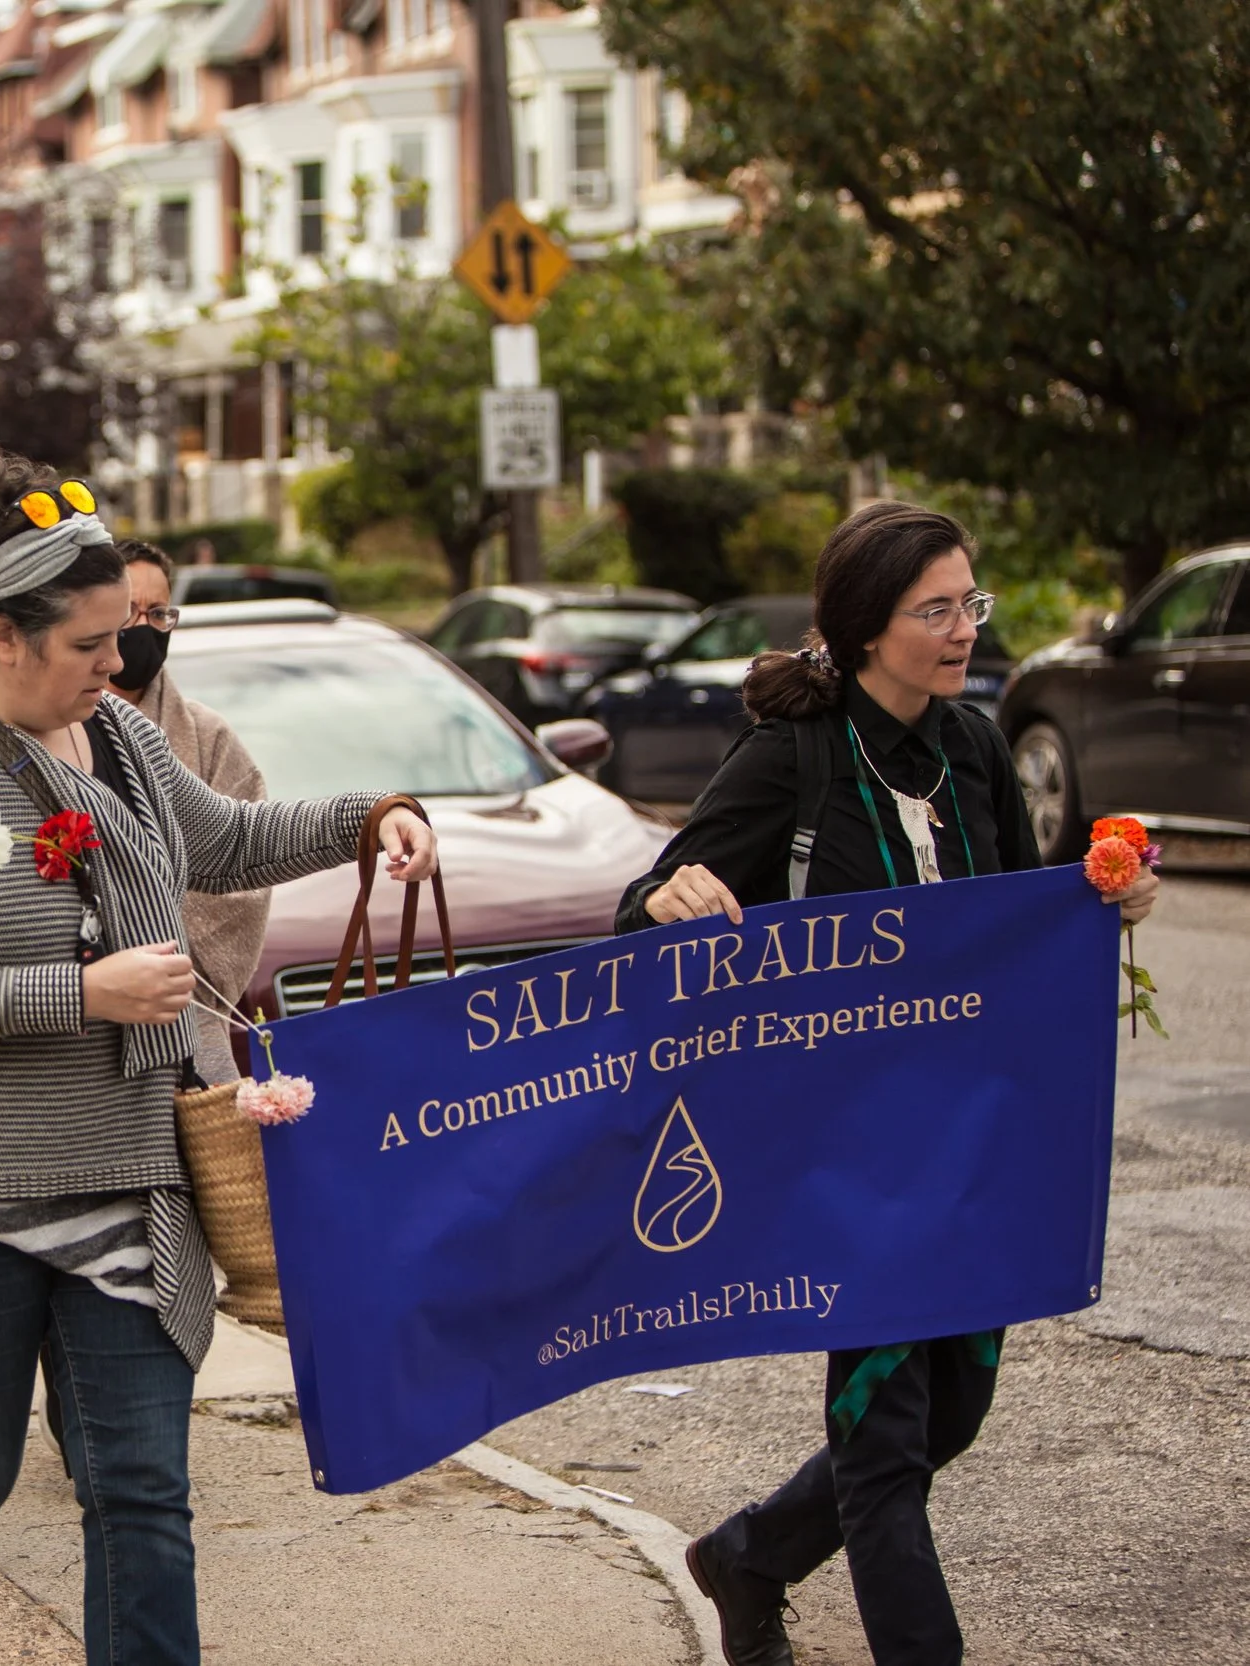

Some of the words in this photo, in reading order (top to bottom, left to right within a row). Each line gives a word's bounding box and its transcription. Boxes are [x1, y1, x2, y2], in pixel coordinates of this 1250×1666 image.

[466, 953, 635, 1053] SALT
[659, 907, 907, 1003] TRAILS
[380, 1112, 410, 1152] A
[418, 1050, 638, 1138] Community
[649, 1015, 748, 1072] Grief
[754, 991, 983, 1050] Experience
[538, 1275, 842, 1366] @SaltTrailsPhilly
